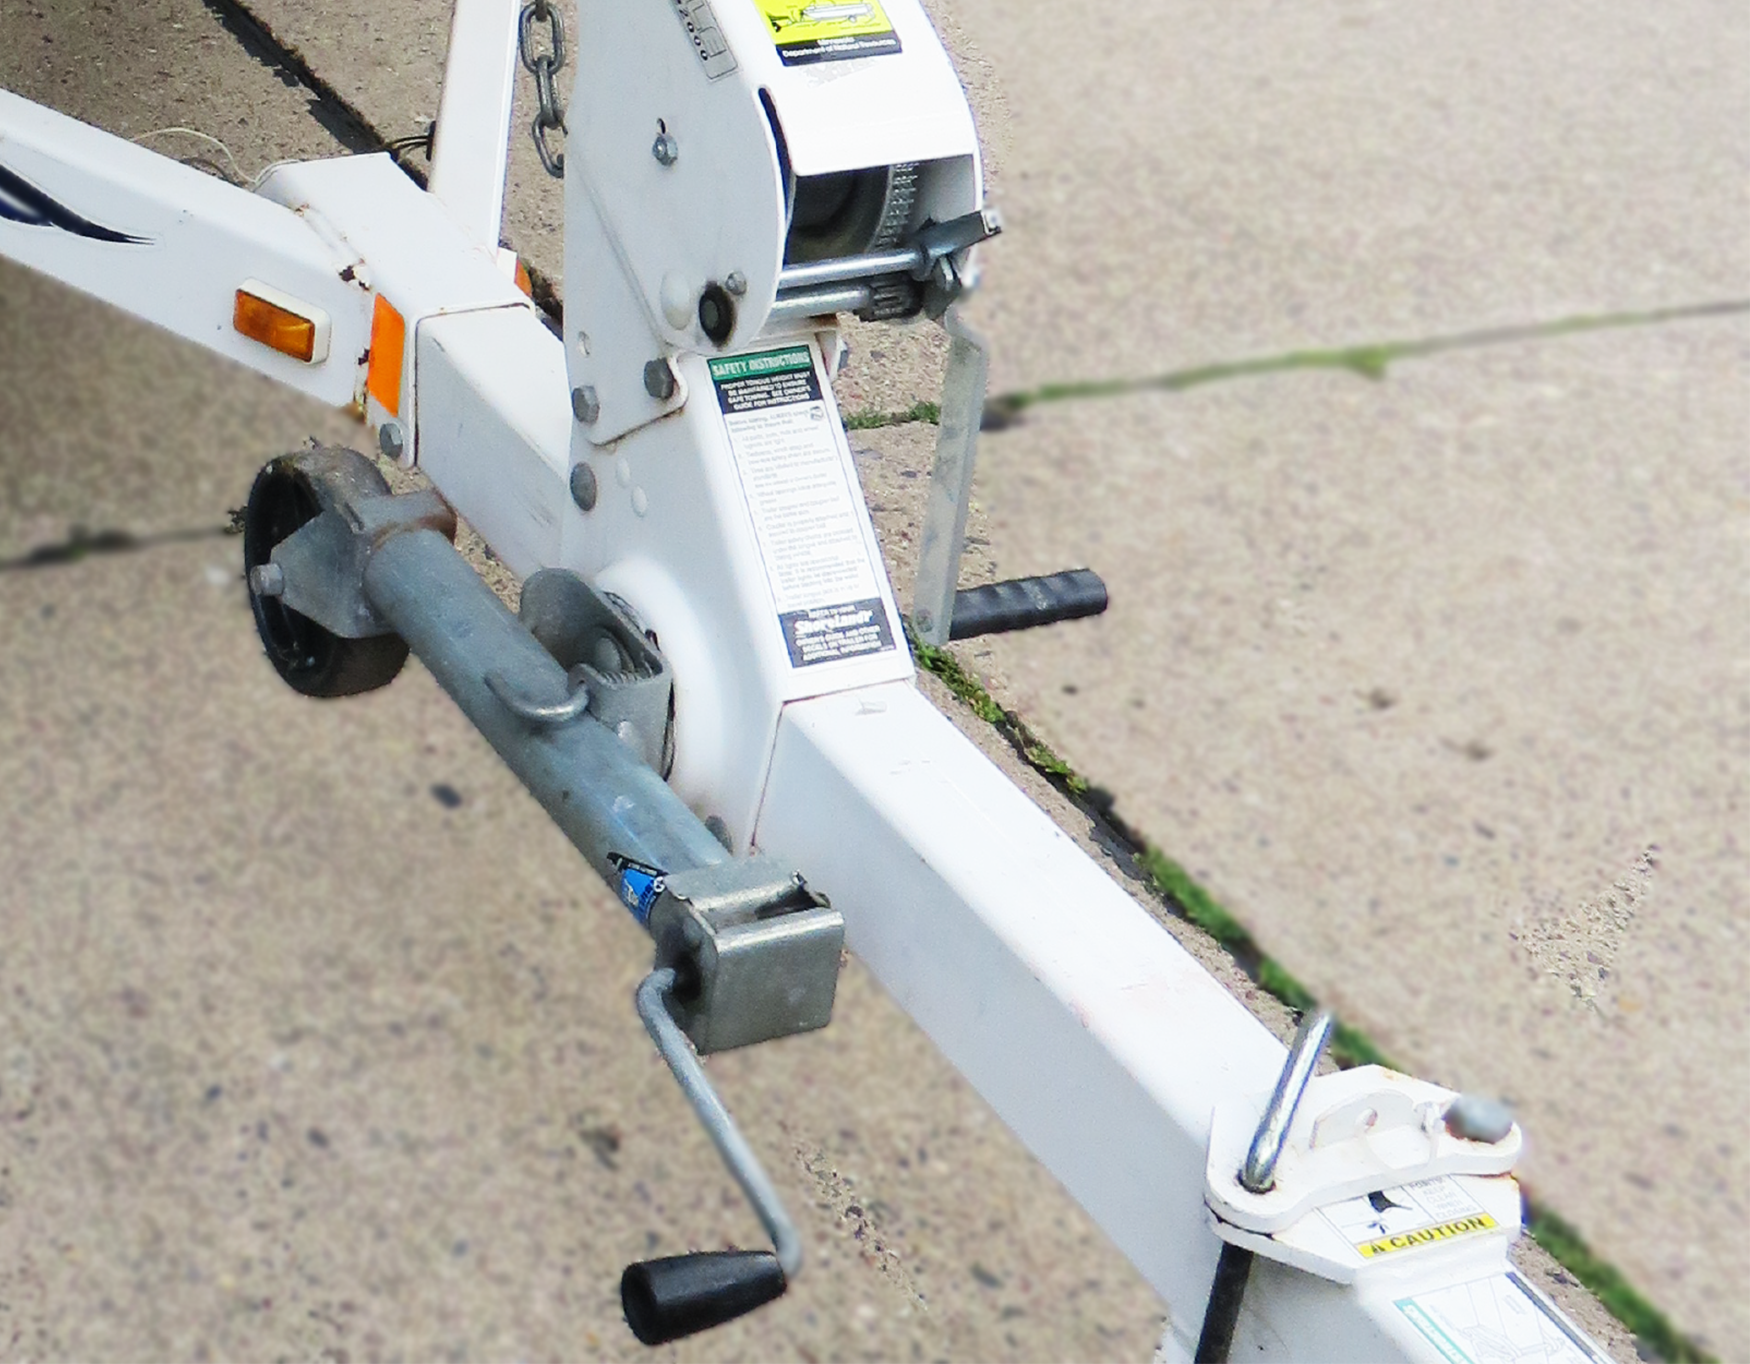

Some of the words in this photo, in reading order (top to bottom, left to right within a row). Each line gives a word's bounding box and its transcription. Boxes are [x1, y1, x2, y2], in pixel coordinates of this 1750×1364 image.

[782, 46, 825, 58] Department
[712, 361, 748, 377] SAFETY
[749, 351, 811, 370] INSTRUCTIONS
[1389, 1216, 1486, 1249] CAUTION
